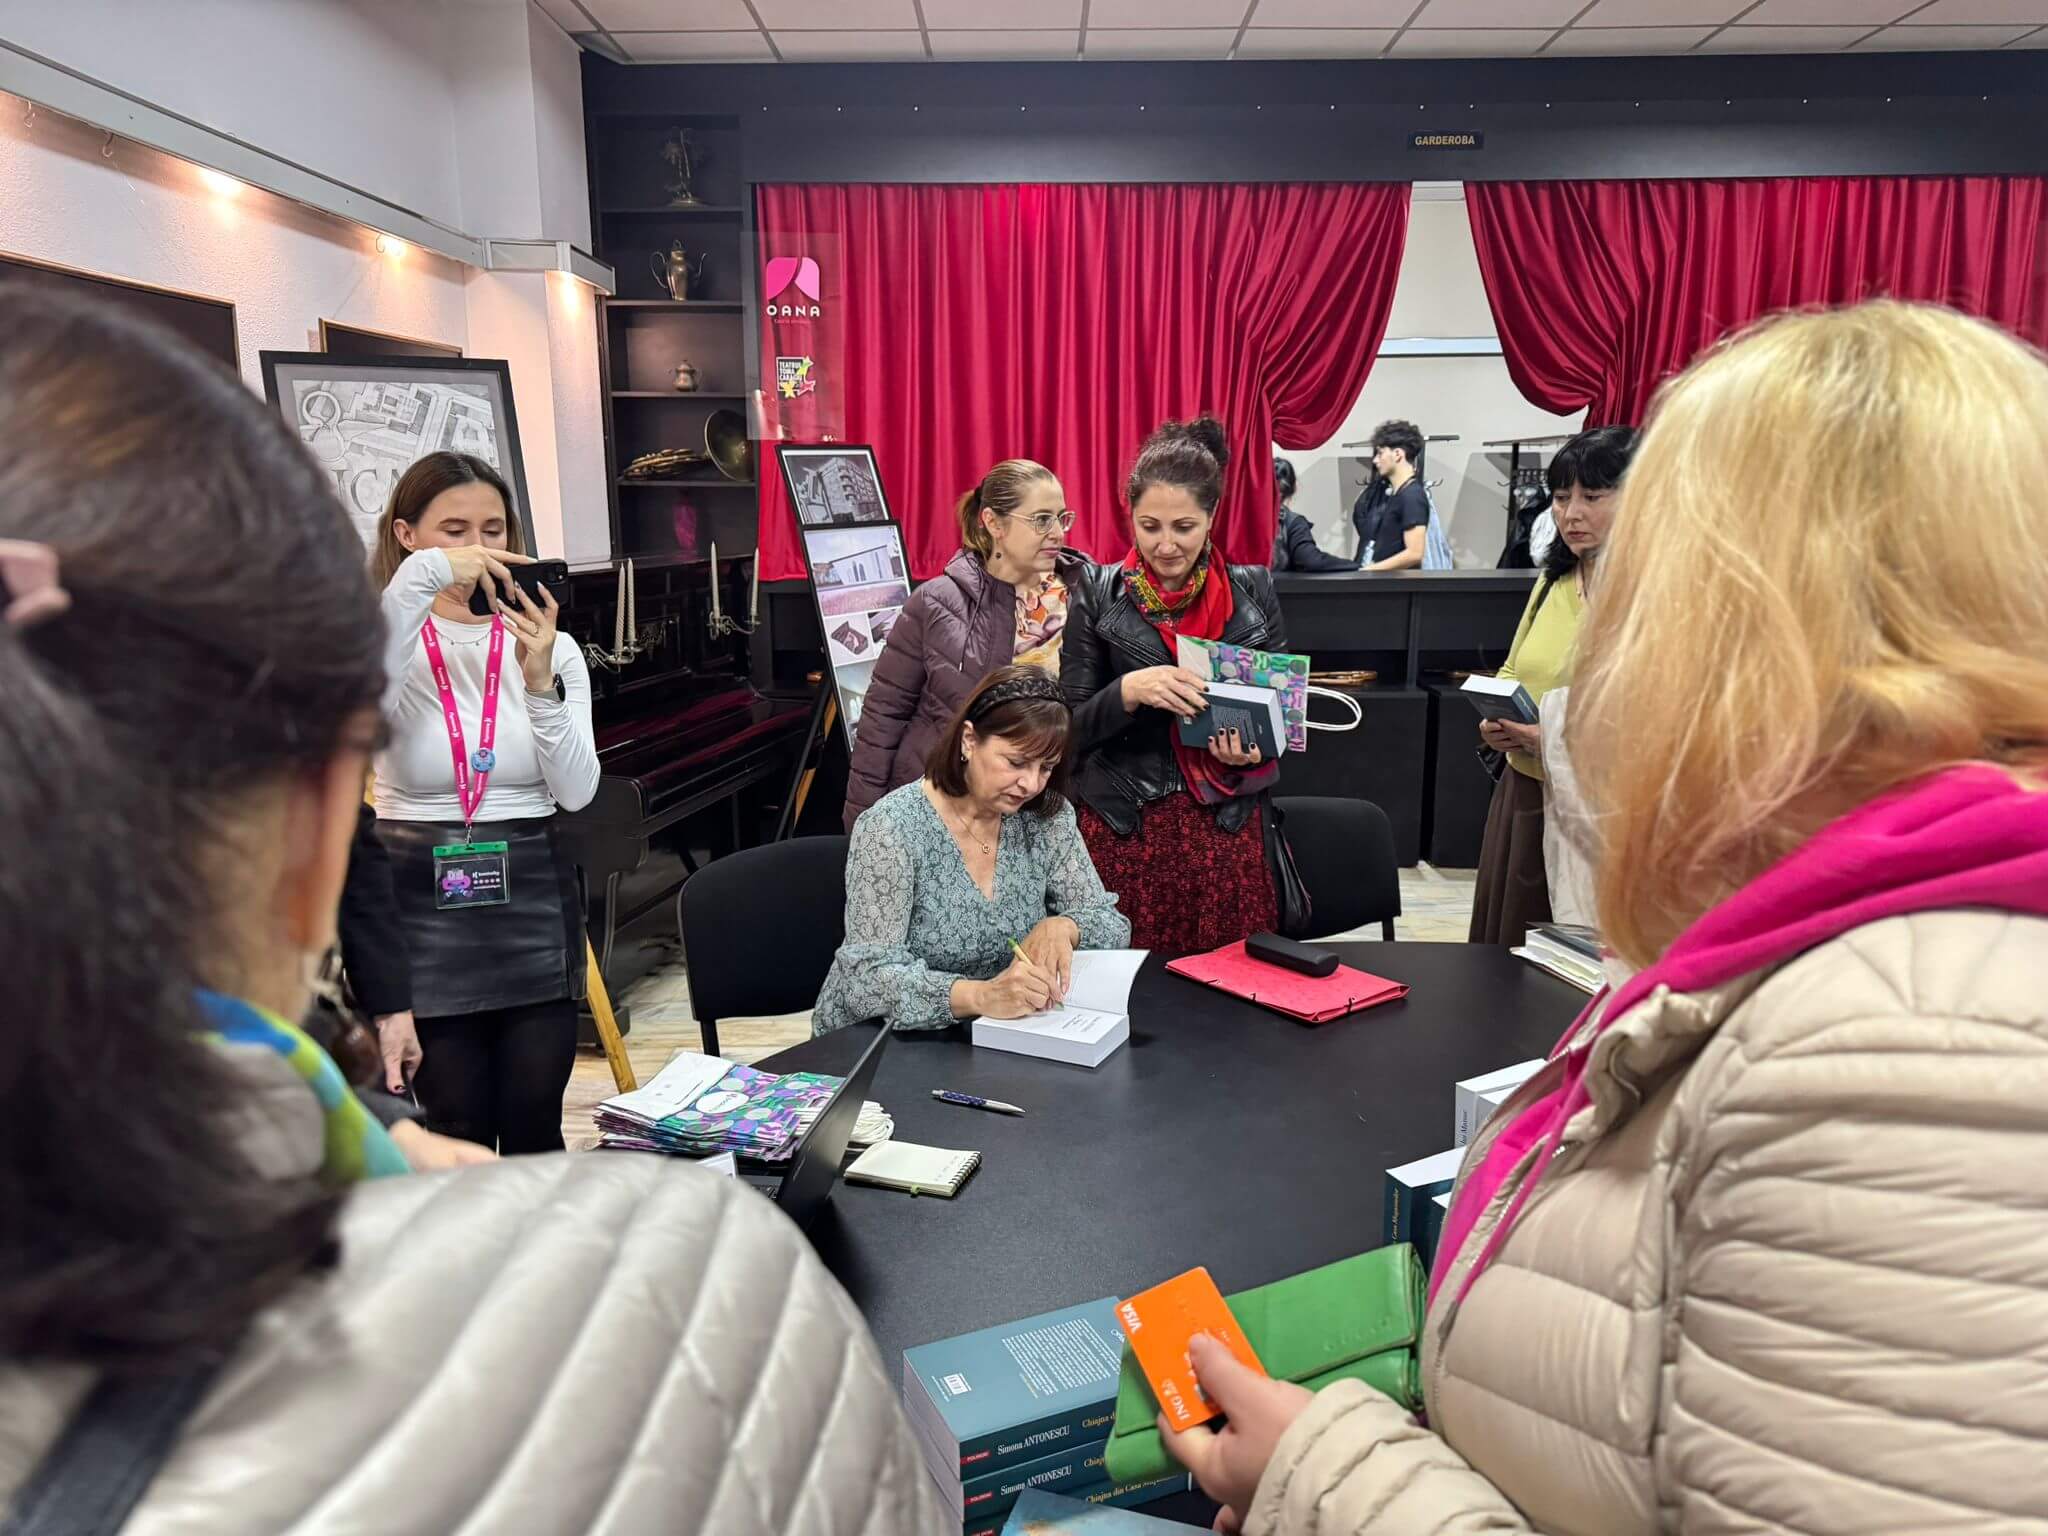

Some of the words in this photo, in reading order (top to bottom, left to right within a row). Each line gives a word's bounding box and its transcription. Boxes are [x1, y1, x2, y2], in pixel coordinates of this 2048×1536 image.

[1415, 135, 1475, 146] GARDEROBA
[766, 305, 820, 317] OANA
[1121, 1302, 1142, 1334] VISA
[1171, 1396, 1190, 1420] ING
[997, 1442, 1023, 1456] Simona
[1024, 1424, 1071, 1448] ANTONESCU
[1001, 1482, 1025, 1496] Simona
[1026, 1464, 1072, 1489] ANTONESCU
